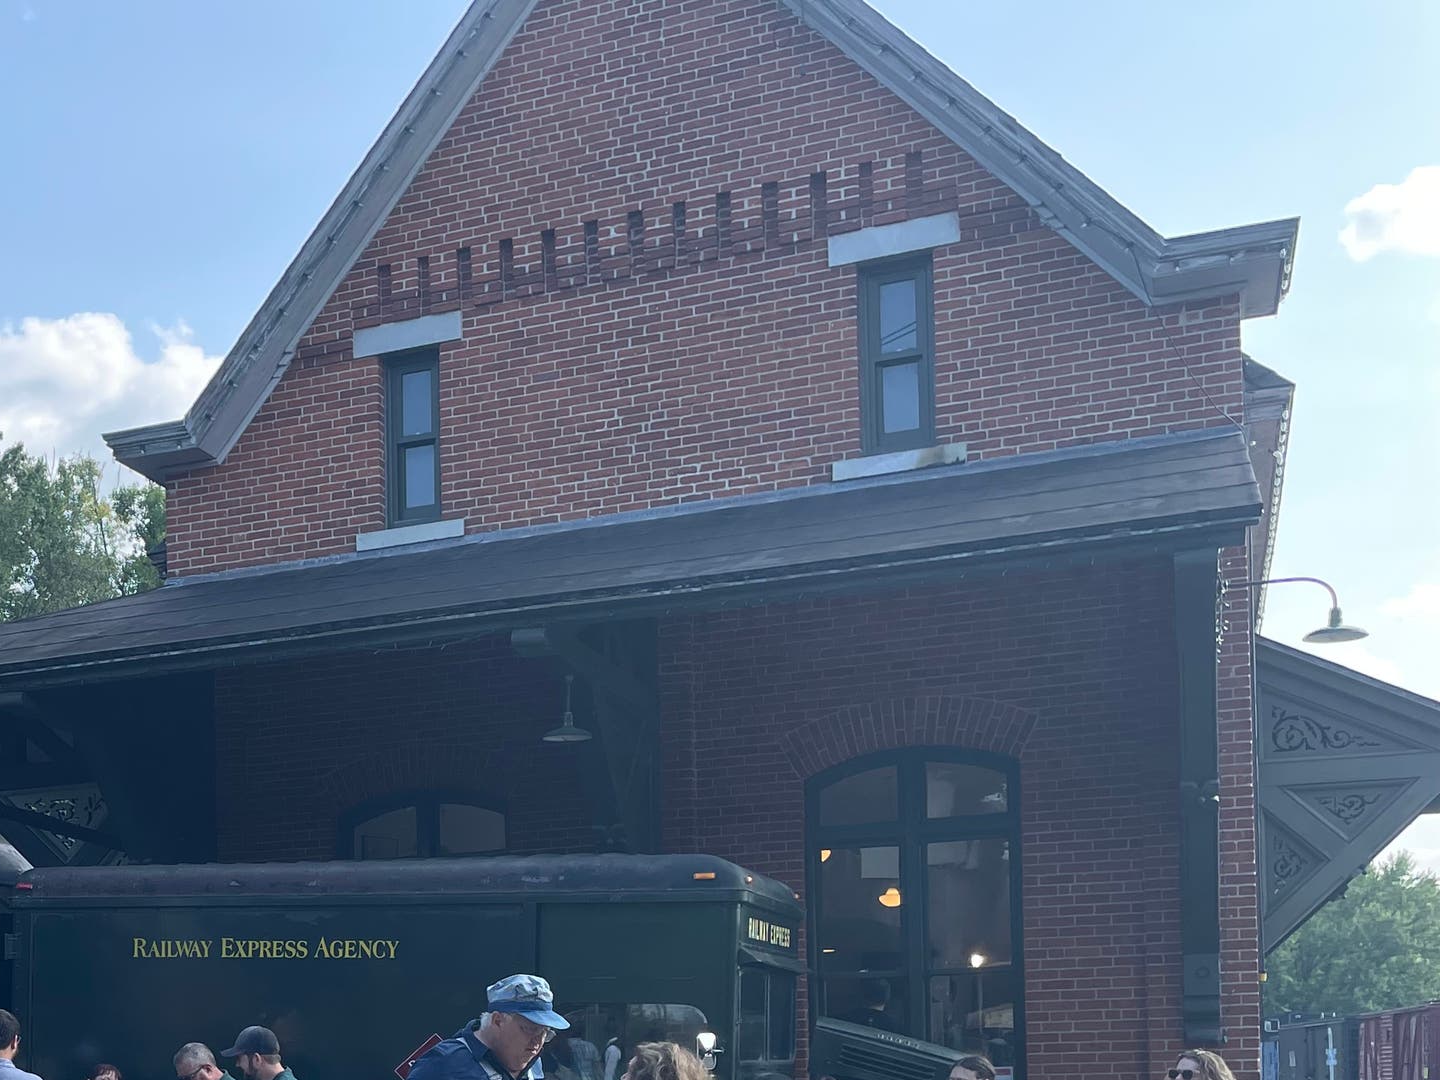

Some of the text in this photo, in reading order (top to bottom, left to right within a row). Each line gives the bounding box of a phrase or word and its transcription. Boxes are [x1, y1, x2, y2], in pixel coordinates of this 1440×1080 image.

[132, 936, 400, 959] RAILWAY EXPRESS AGENCY
[770, 924, 791, 948] EXPRESS
